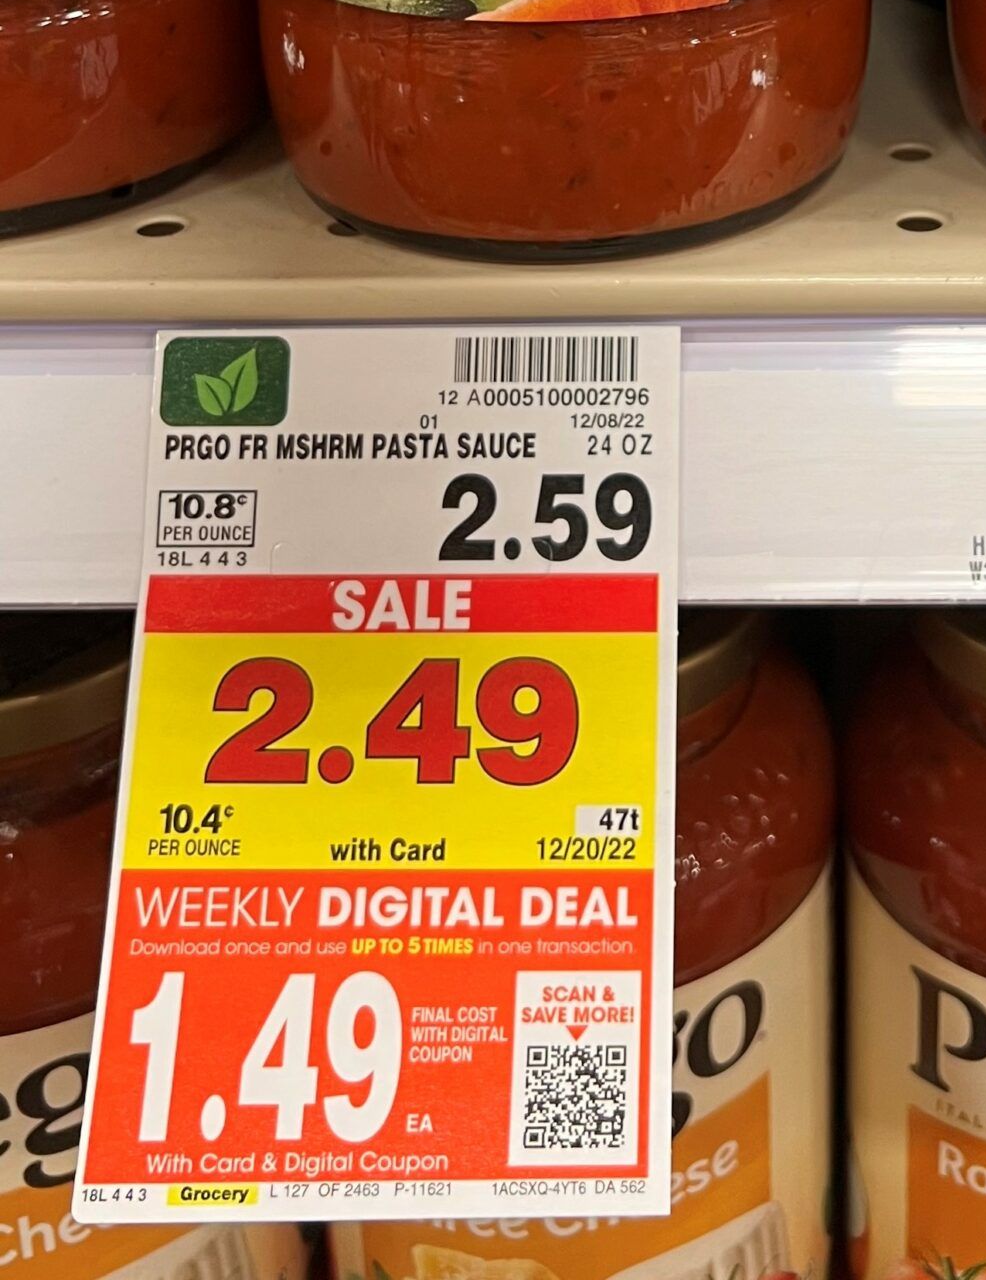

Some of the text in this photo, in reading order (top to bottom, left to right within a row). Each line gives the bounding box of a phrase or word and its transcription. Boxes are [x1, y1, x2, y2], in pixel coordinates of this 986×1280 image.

[438, 388, 650, 407] 12 A0005100002796
[419, 414, 439, 430] 01
[571, 413, 645, 430] 12/08/22
[164, 432, 653, 461] PRGO FR MSHRM PASTA SAUCE 24 OZ
[438, 472, 653, 562] 2.59
[163, 525, 252, 541] PER OUNCE
[157, 551, 192, 567] 18L
[332, 579, 472, 632] SALE
[203, 655, 581, 786] 2.49
[599, 806, 640, 832] 47t
[148, 837, 636, 861] PER OUNCE with Card 12/20/22
[135, 885, 638, 928] WEEKLY DIGITAL DEAL
[129, 937, 221, 956] Download
[225, 941, 270, 956] once
[275, 937, 312, 955] and
[317, 941, 347, 955] use
[352, 937, 377, 954] UP
[380, 937, 403, 954] TO
[408, 936, 420, 954] 5
[423, 936, 473, 954] TIMES
[478, 936, 493, 954] in
[498, 940, 531, 955] one
[541, 985, 615, 1003] SCAN &
[412, 1006, 498, 1023] FINAL COST
[521, 1006, 635, 1023] SAVE MORE!
[411, 1026, 508, 1043] WITH DIGITAL
[130, 970, 403, 1143] 1.49
[409, 1046, 472, 1063] COUPON
[406, 1114, 433, 1134] EA
[147, 1151, 449, 1176] With Card & Digital Coupon
[180, 1186, 249, 1203] Grocery
[269, 1184, 278, 1198] L
[284, 1184, 309, 1198] 127
[318, 1183, 340, 1198] OF
[344, 1183, 380, 1197] 2463
[394, 1183, 453, 1197] P-11621
[594, 1181, 616, 1195] DA
[620, 1180, 646, 1195] 562
